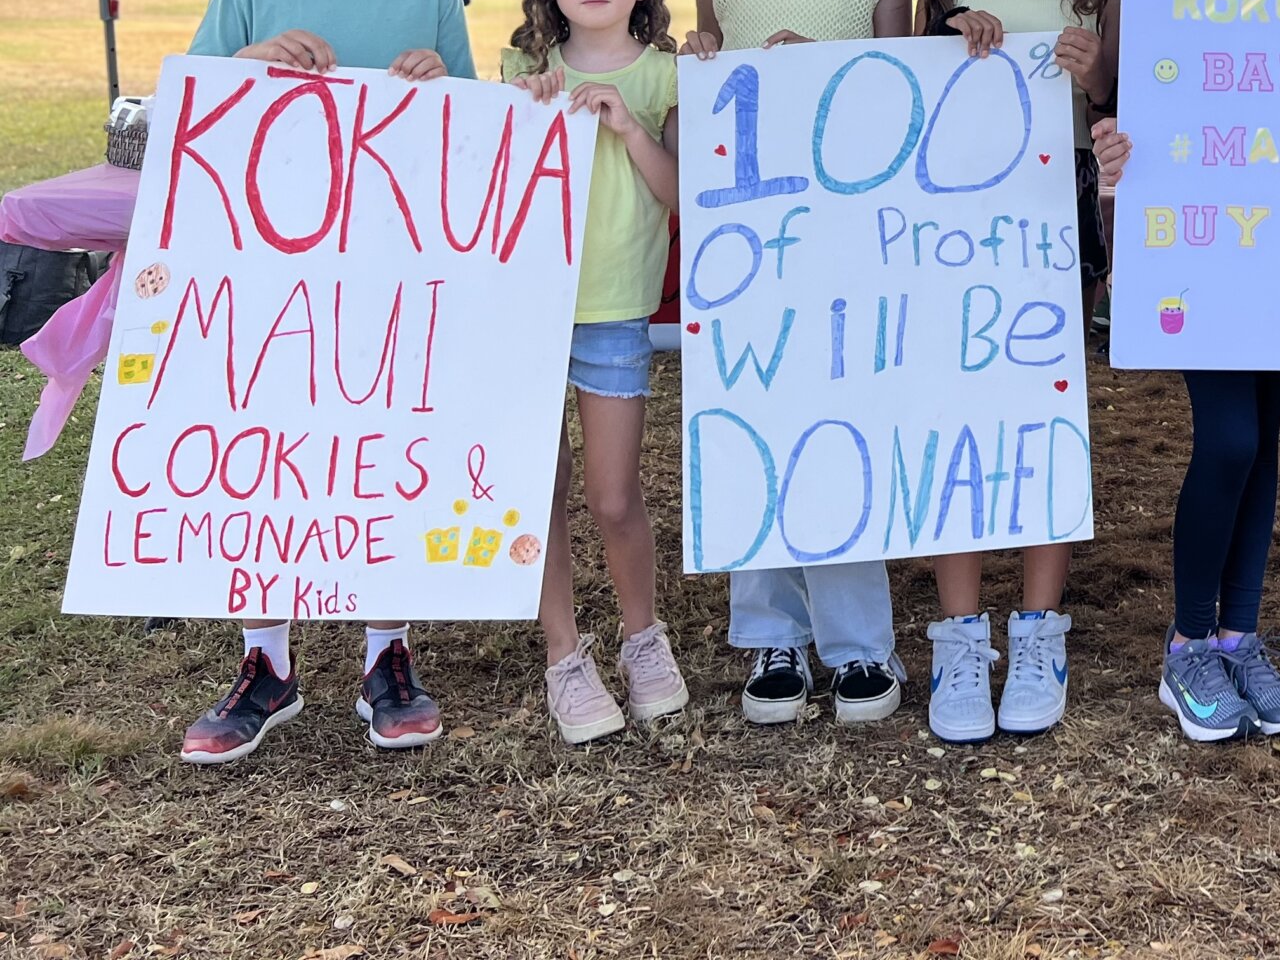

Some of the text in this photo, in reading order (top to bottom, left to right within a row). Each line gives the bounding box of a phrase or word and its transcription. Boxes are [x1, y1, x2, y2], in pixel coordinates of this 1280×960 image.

[686, 206, 1077, 310] Of Profits
[1144, 205, 1271, 248] BUY
[147, 276, 445, 412] MAUI
[960, 285, 1066, 373] Be
[111, 422, 495, 502] COOKIES &
[104, 507, 396, 567] LEMONADE
[228, 567, 359, 619] BY Kids
